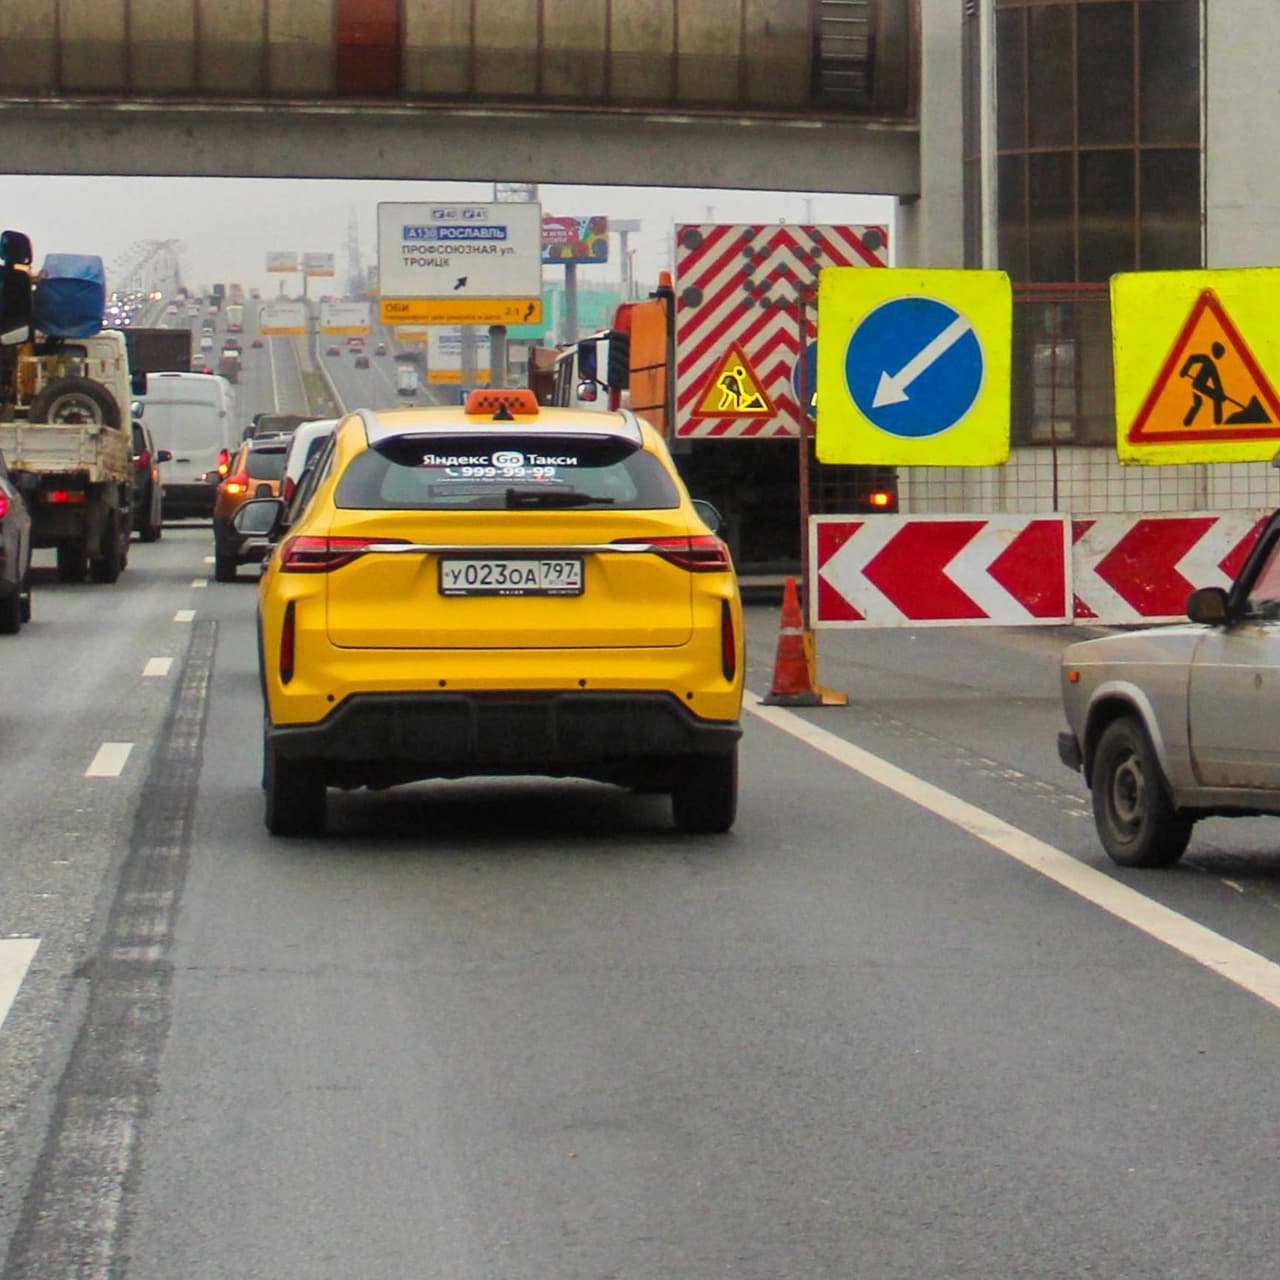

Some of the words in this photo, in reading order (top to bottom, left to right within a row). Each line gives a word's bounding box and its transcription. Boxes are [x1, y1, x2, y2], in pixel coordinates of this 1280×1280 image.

[439, 227, 506, 238] РОСЛАВЛЬ
[402, 245, 497, 255] ПРОФСОЮЗНАЯ
[423, 454, 489, 467] Яндекс
[494, 452, 522, 466] Go
[527, 454, 578, 465] Такси
[461, 467, 556, 477] 999-99-99
